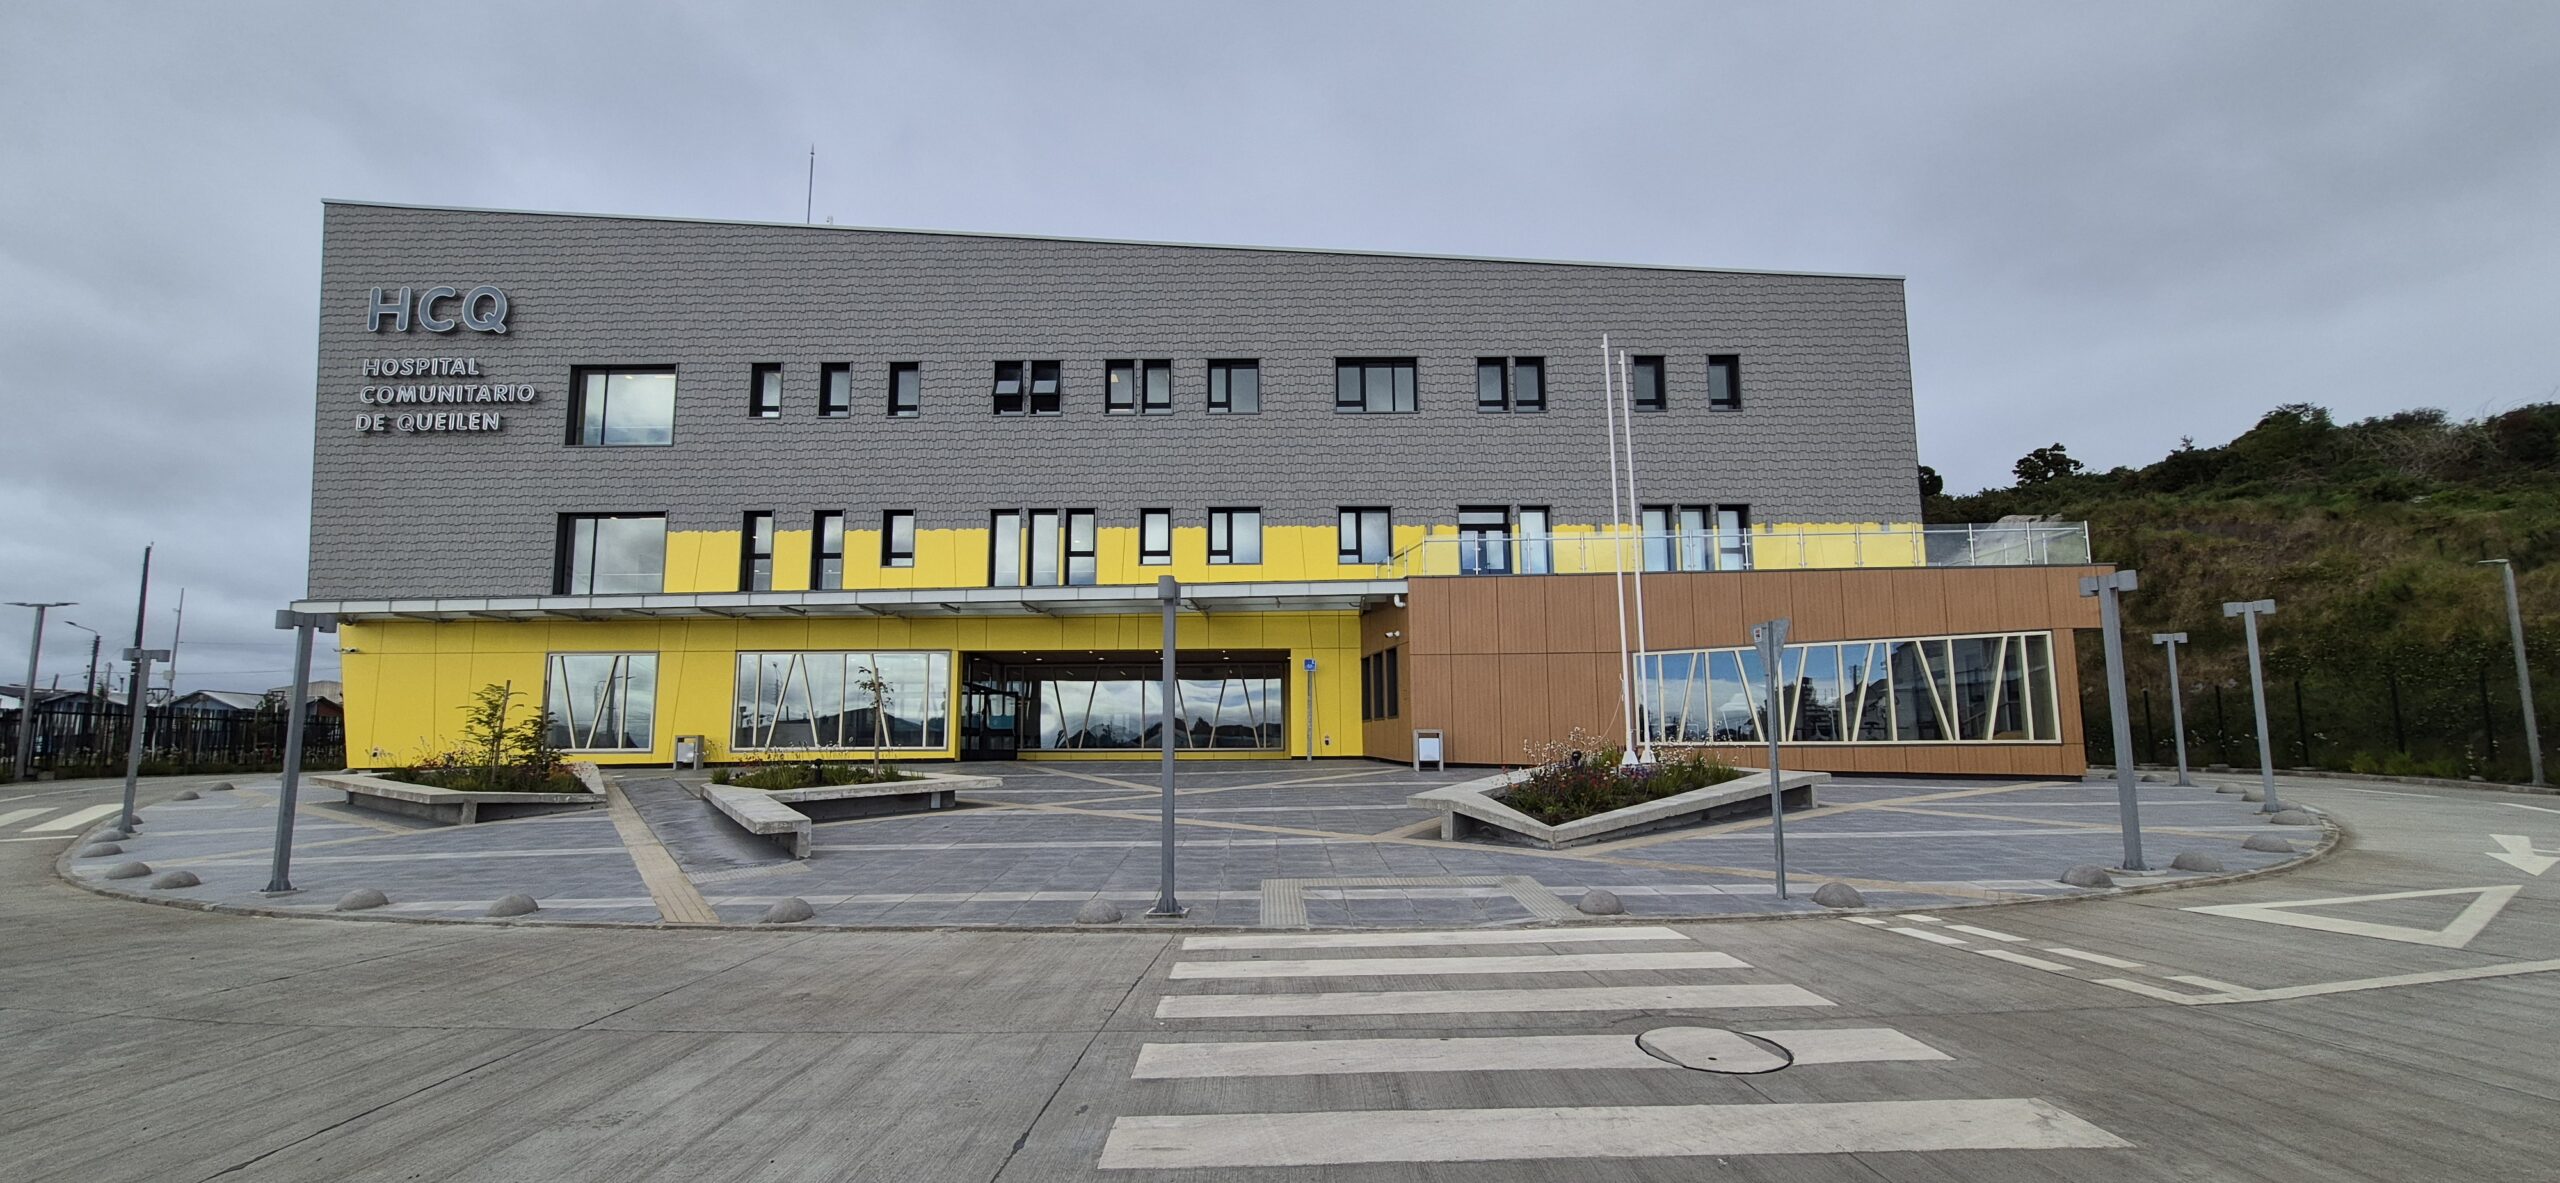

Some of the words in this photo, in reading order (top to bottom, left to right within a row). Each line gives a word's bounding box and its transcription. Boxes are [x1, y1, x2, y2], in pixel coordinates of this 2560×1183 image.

[367, 285, 508, 333] HCQ
[363, 358, 479, 376] HOSPITAL
[360, 384, 535, 404] COMUNITARIO
[355, 413, 385, 431] DE
[397, 412, 500, 432] QUEILEN
